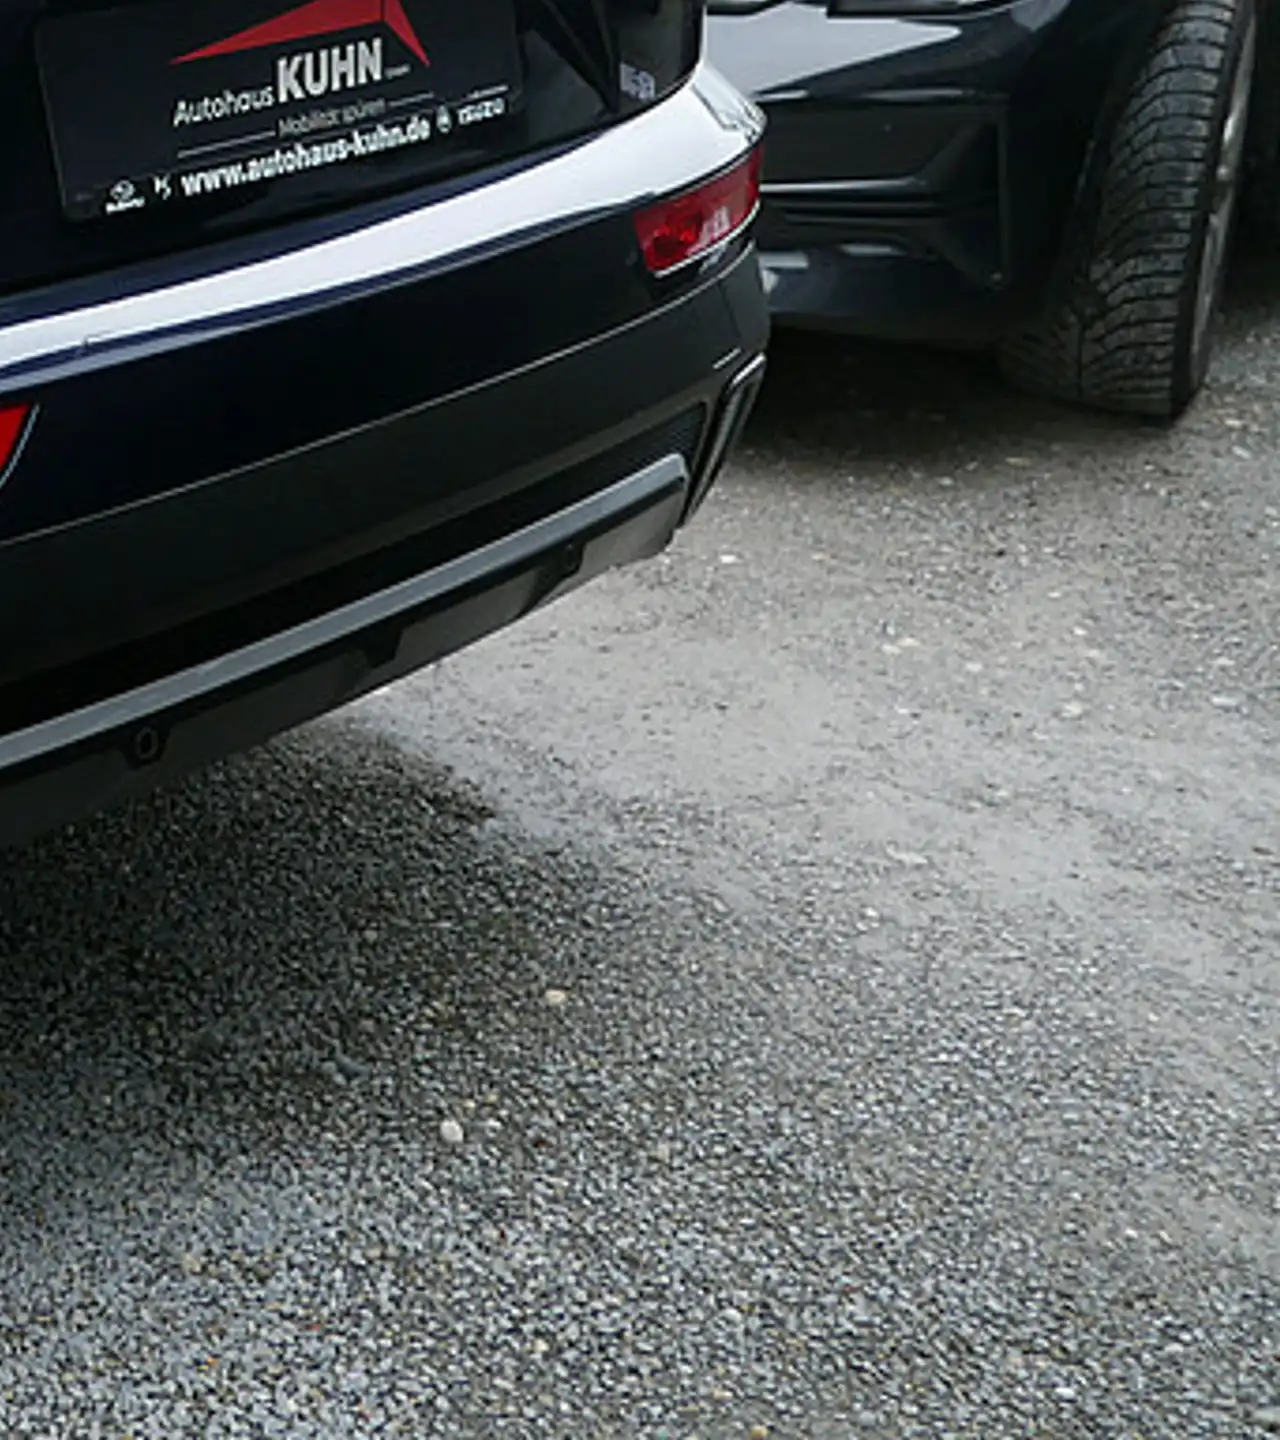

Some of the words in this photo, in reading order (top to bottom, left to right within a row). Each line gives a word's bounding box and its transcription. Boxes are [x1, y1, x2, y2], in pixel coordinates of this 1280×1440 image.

[173, 84, 275, 128] Autohaus
[277, 37, 383, 104] KUHN
[181, 115, 431, 197] www.autohaus-kuhn.de
